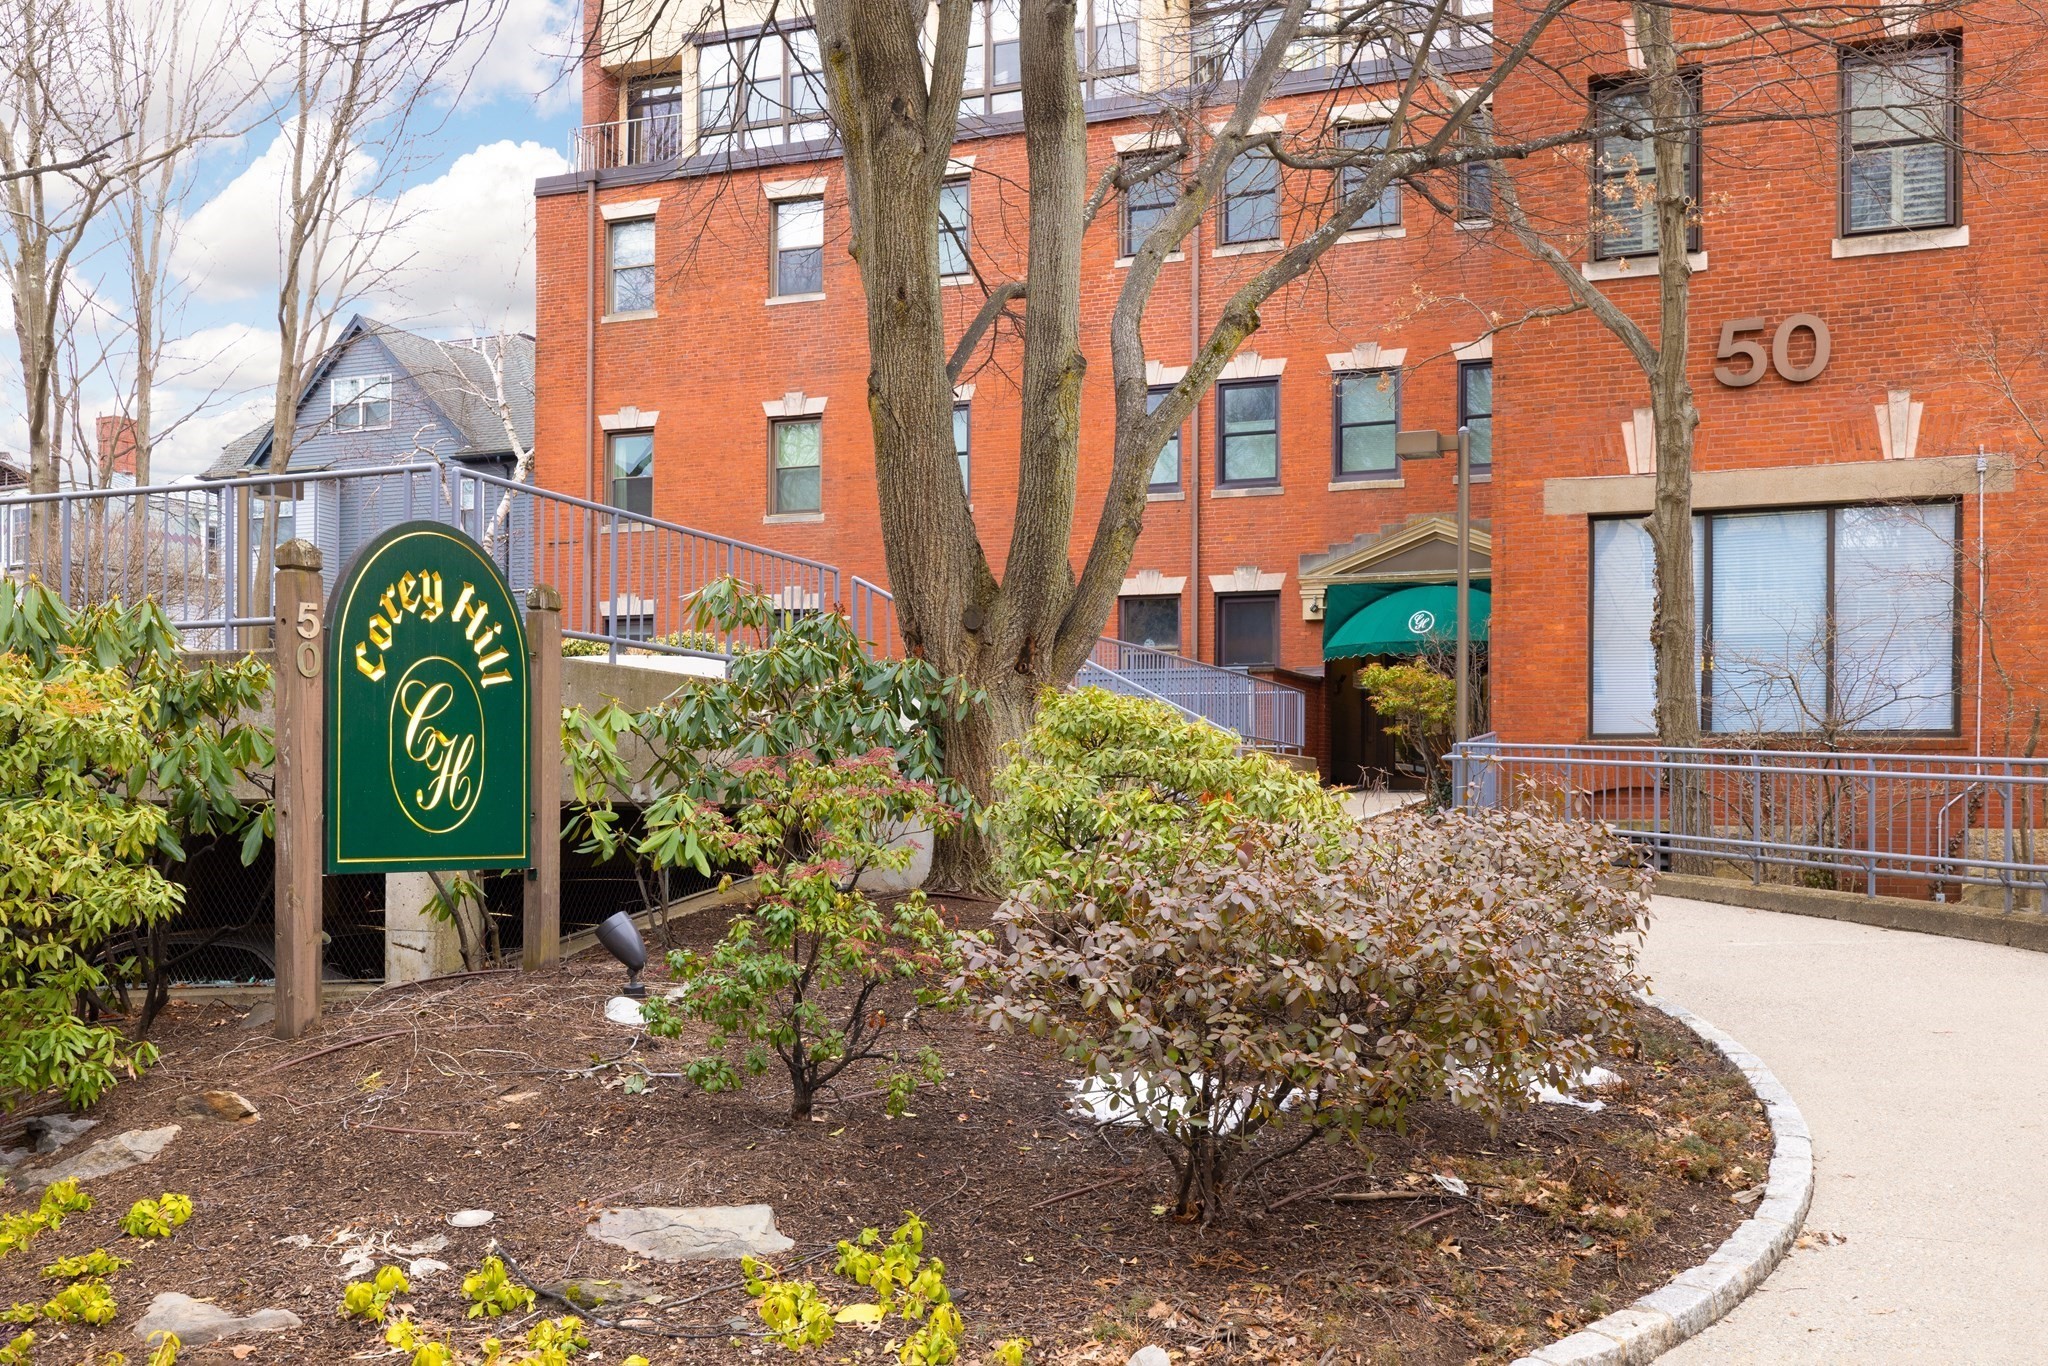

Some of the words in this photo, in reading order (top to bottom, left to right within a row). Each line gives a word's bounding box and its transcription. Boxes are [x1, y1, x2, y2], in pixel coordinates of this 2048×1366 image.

[1714, 313, 1831, 387] 50
[355, 569, 444, 682] Corey
[451, 582, 513, 689] Hill
